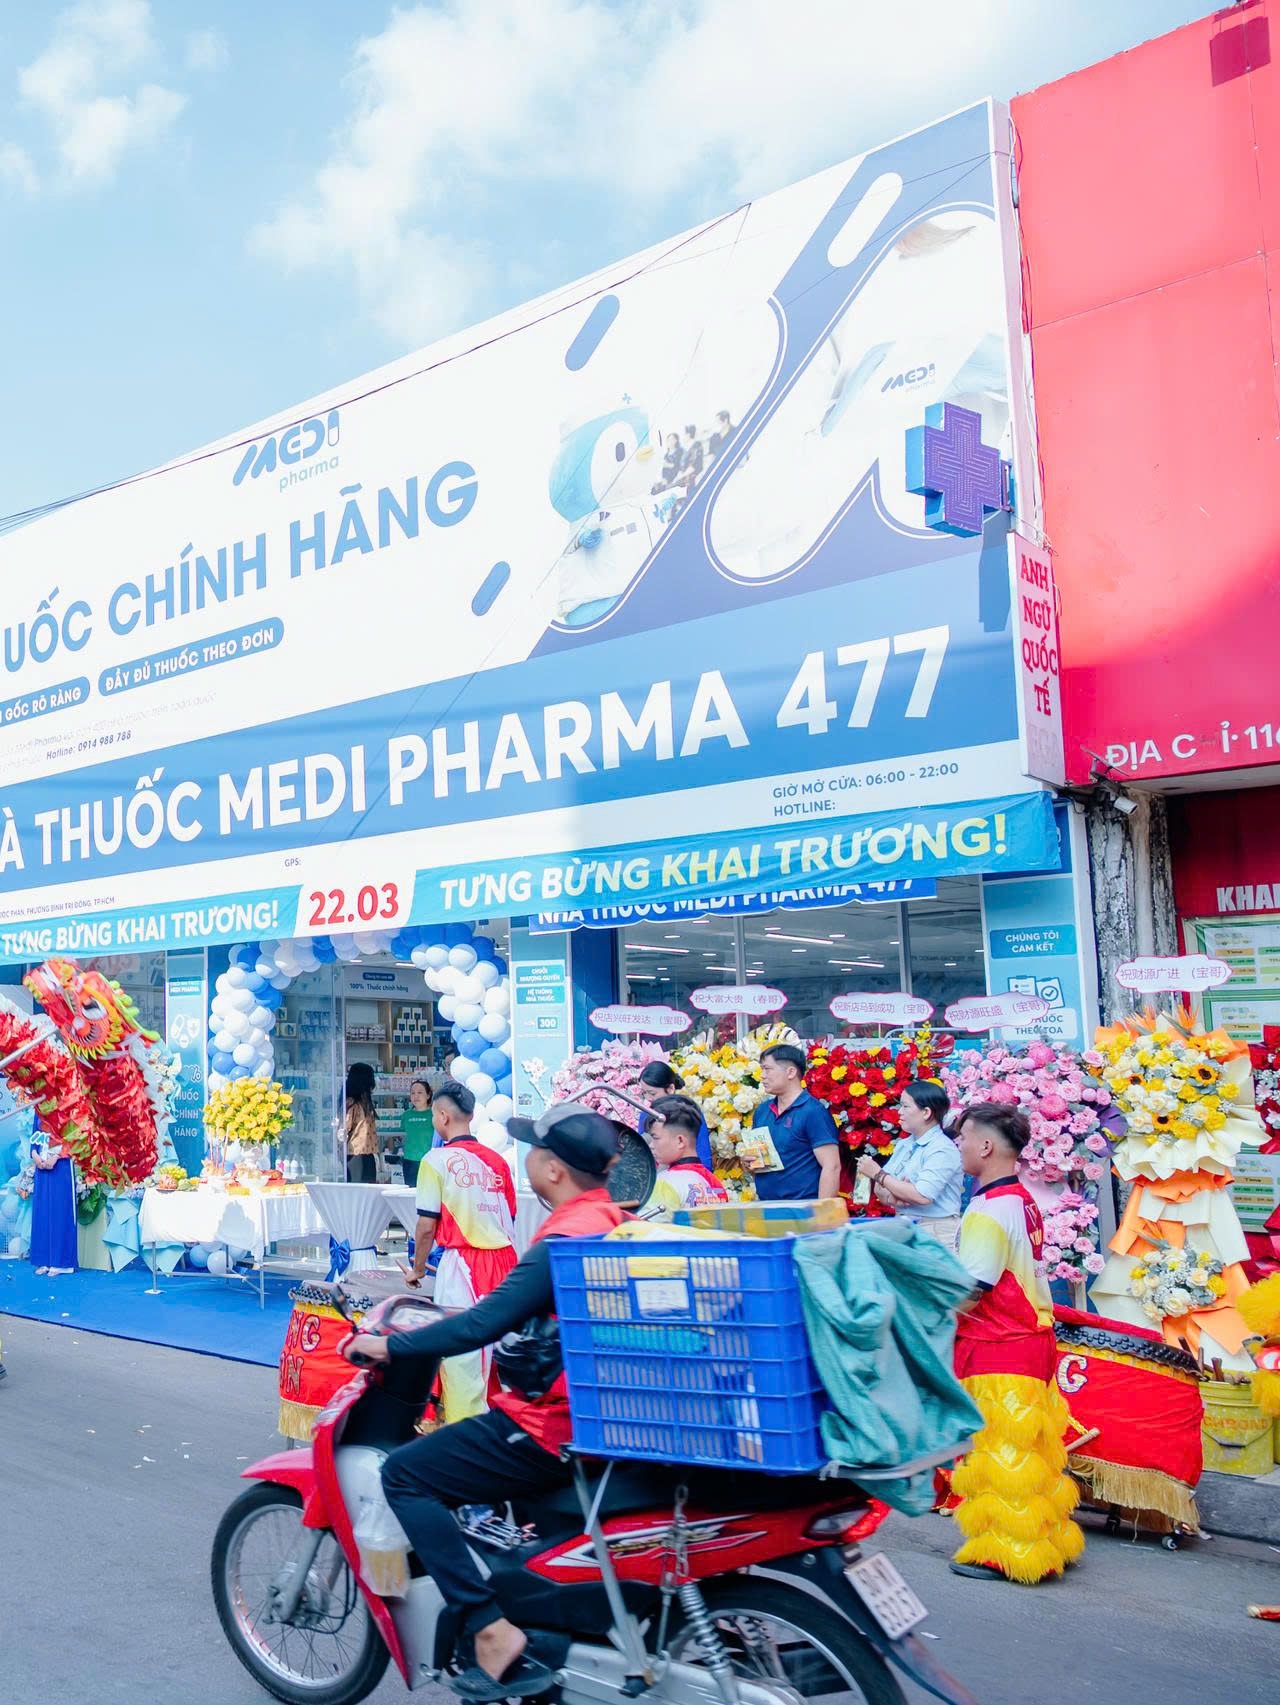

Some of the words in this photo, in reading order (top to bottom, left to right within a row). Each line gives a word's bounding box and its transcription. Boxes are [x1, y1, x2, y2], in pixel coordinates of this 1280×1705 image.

[232, 409, 340, 487] MEDI
[279, 456, 340, 492] pharma
[108, 535, 268, 637] CHÍNH
[290, 461, 478, 580] HÃNG
[1020, 553, 1049, 592] ANH
[1022, 595, 1051, 632] NGỮ
[105, 667, 130, 692] ĐẦY
[133, 658, 151, 683] ĐỦ
[153, 646, 199, 678] THUỐC
[201, 640, 238, 664] THEO
[241, 627, 275, 652] ĐƠN
[1022, 632, 1058, 676] QUỐC
[5, 701, 30, 721] GỐC
[32, 696, 47, 713] RÕ
[50, 687, 82, 709] RÀNG
[1034, 676, 1051, 717] TẾ
[34, 767, 203, 866] THUỐC
[219, 731, 367, 837] MEDI
[388, 671, 751, 807] PHARMA
[775, 624, 952, 735] 477
[46, 744, 75, 760] Hotline:
[77, 738, 97, 753] 0914
[99, 734, 114, 747] 988
[1105, 739, 1163, 771] ĐỊA
[773, 784, 798, 799] GIỜ
[802, 779, 825, 794] MỞ
[828, 775, 862, 791] CỬA:
[865, 770, 906, 786] 06:00
[919, 762, 959, 779] 22:00
[773, 801, 836, 817] HOTLINE:
[284, 856, 302, 868] GPS:
[440, 868, 533, 909] TƯNG
[541, 851, 649, 898] BỪNG
[660, 846, 759, 885] KHAI
[772, 814, 1008, 870] TRƯƠNG!
[309, 883, 399, 927] 22.03
[1, 928, 51, 956] TƯNG
[56, 919, 112, 951] BỪNG
[117, 914, 165, 945] KHAI
[170, 899, 278, 940] TRƯƠNG!
[1005, 931, 1041, 943] CHÚNG
[1042, 931, 1059, 941] TÔI
[1011, 943, 1033, 953] CAM
[1035, 940, 1055, 952] KẾT
[539, 1019, 556, 1028] 300
